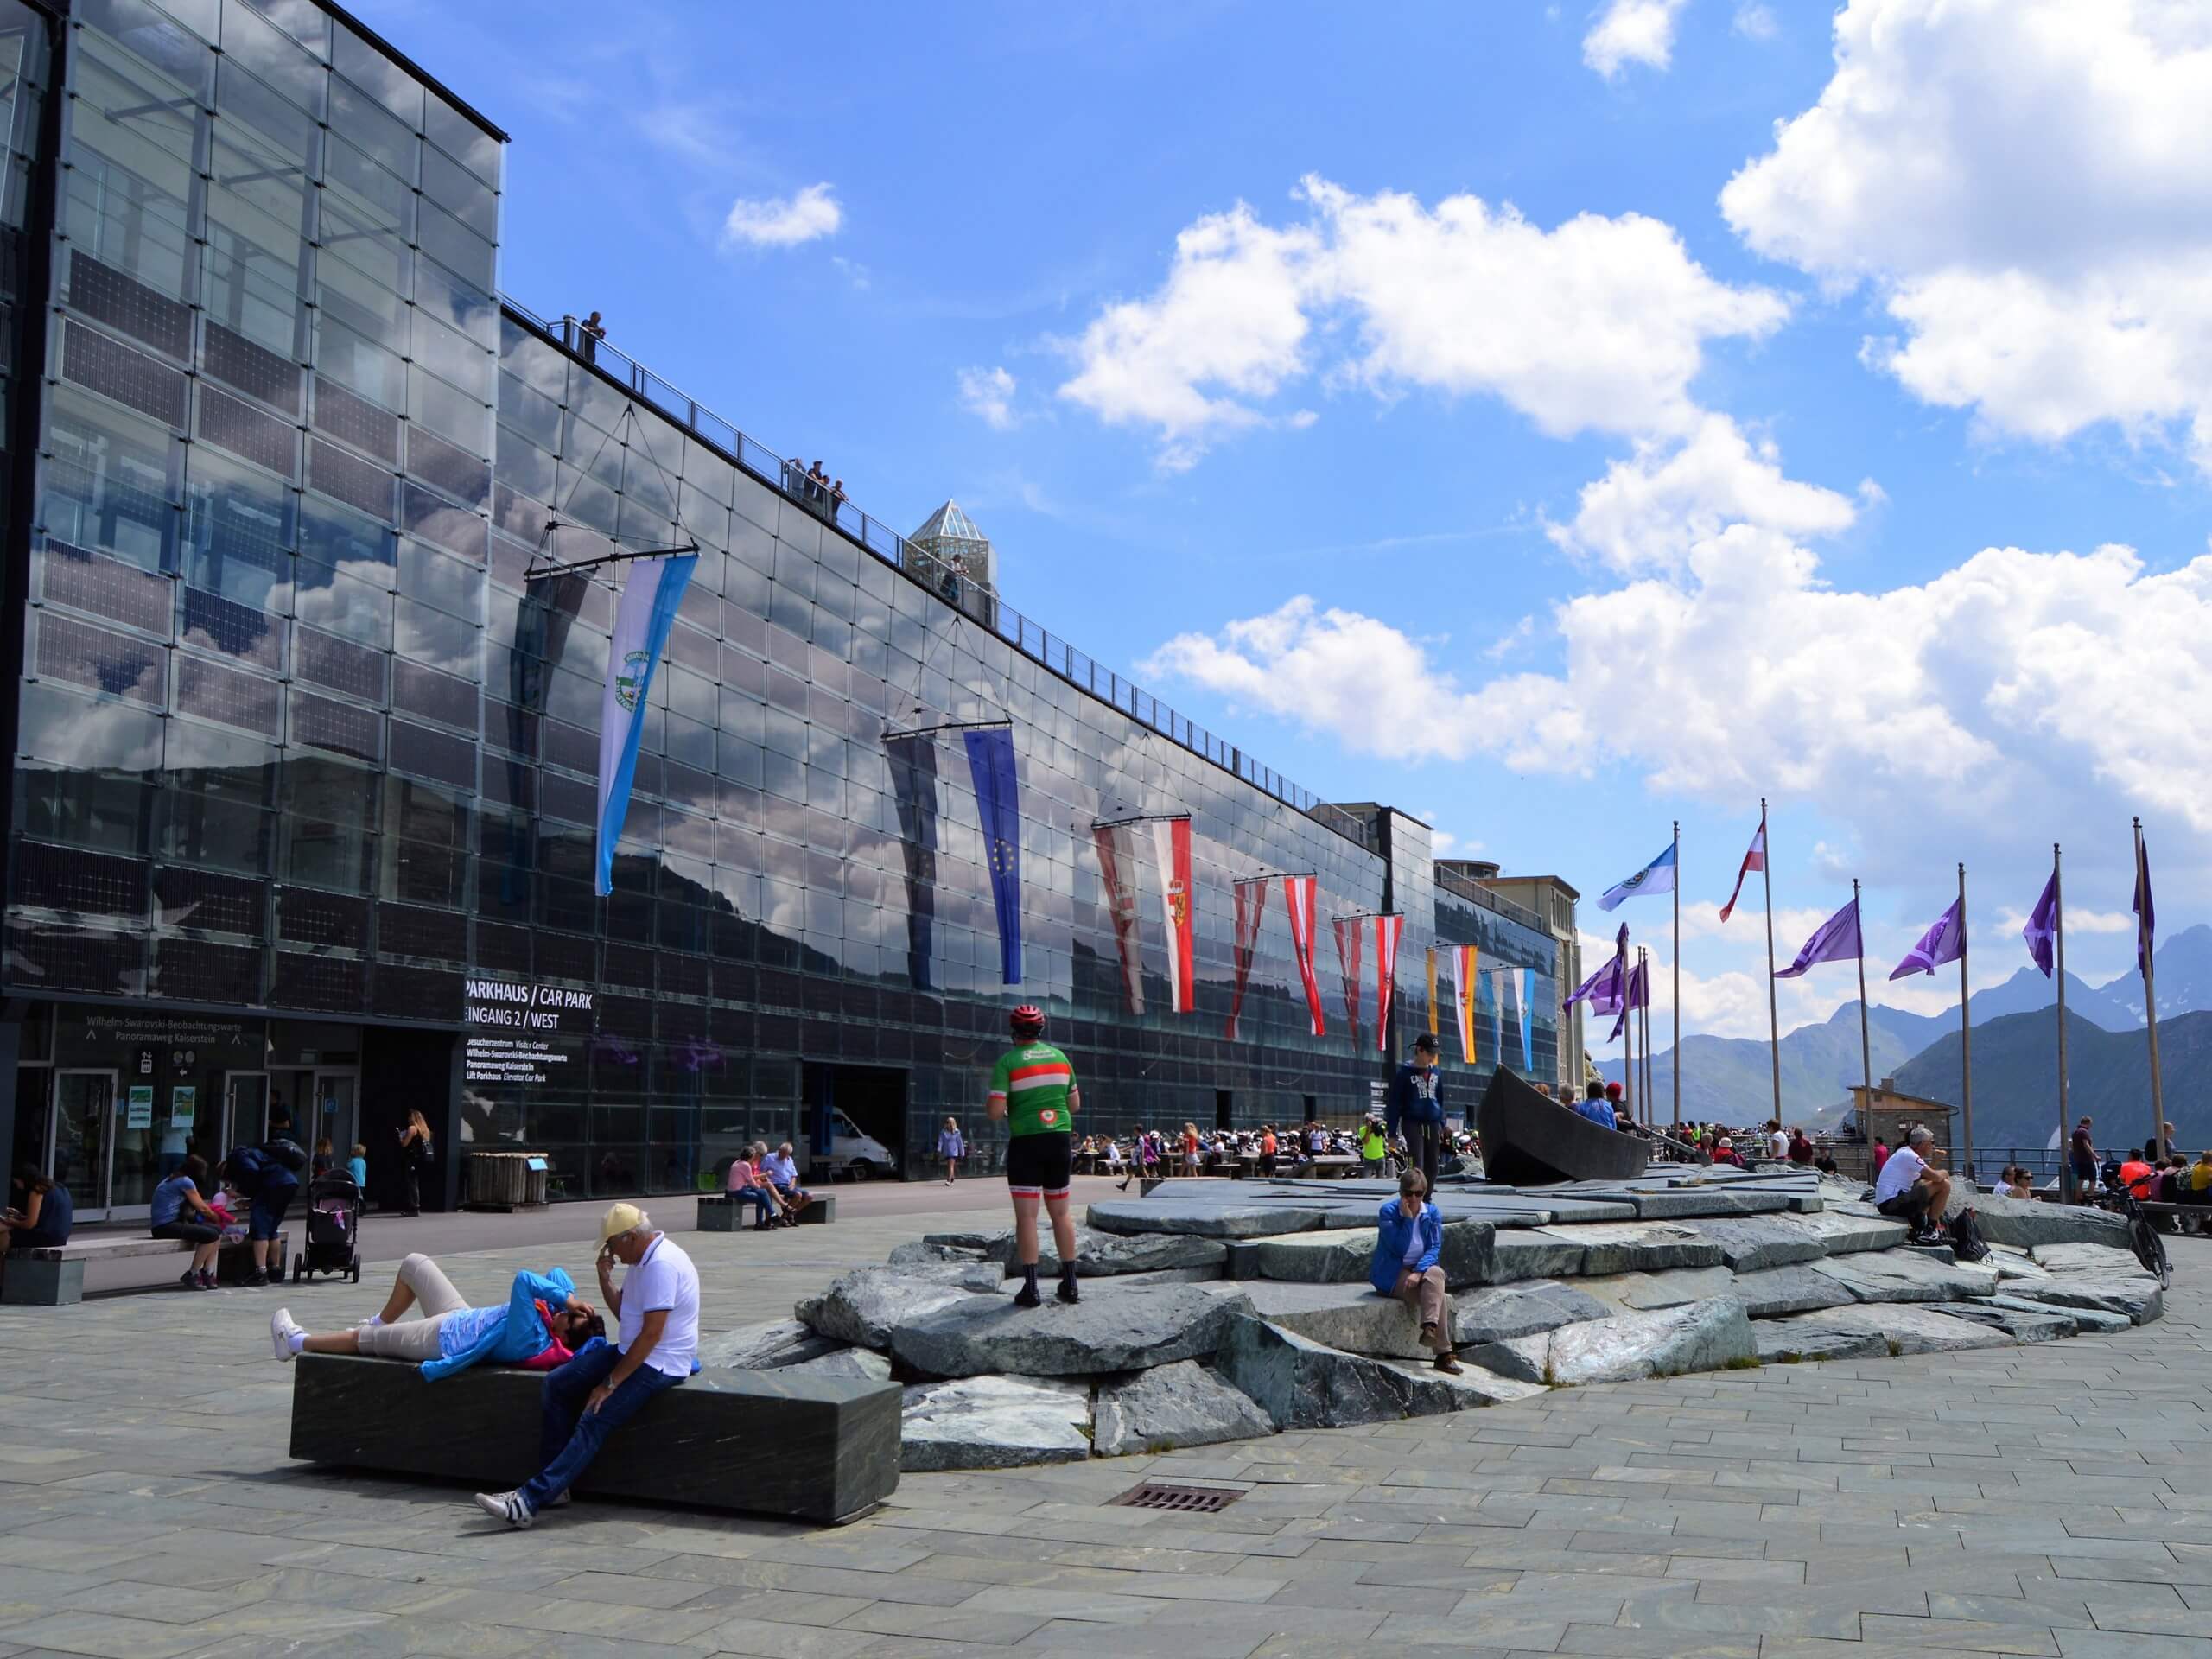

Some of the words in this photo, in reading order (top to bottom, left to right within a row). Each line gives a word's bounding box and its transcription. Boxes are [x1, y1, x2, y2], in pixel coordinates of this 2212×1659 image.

[531, 986, 537, 1007] /
[540, 988, 563, 1007] CAR
[565, 991, 593, 1010] PARK
[87, 1016, 242, 1033] Wilhelm-Swarovski-Beobachtungswarte
[514, 1011, 521, 1027] 2
[523, 1010, 529, 1029] /
[531, 1012, 559, 1029] WEST
[175, 1033, 215, 1044] Kaiserstein
[532, 1041, 549, 1050] Center
[467, 1059, 505, 1071] Panoramaweg
[505, 1061, 534, 1071] Kaiserstein
[467, 1071, 476, 1080] Lift
[477, 1071, 501, 1081] Parkhaus
[525, 1073, 534, 1082] Car
[535, 1073, 546, 1083] Park
